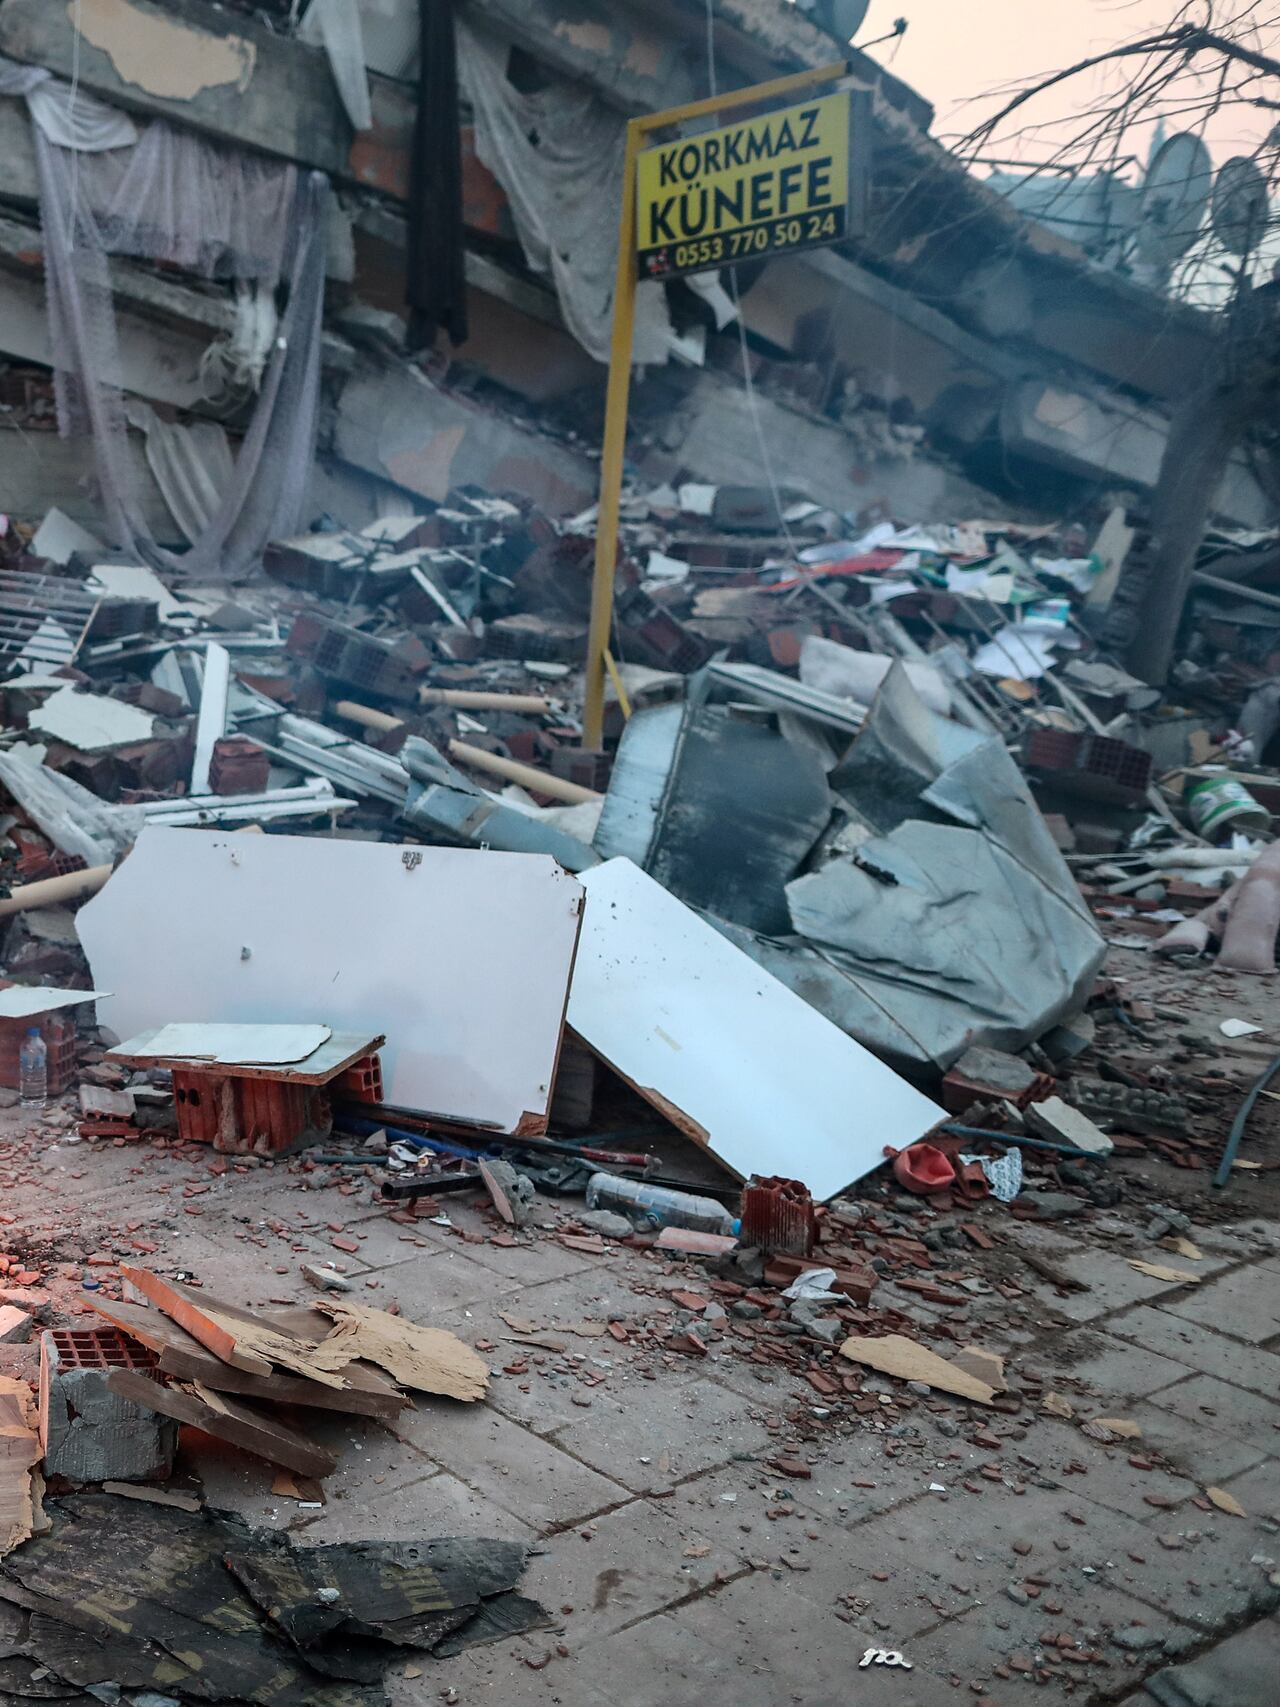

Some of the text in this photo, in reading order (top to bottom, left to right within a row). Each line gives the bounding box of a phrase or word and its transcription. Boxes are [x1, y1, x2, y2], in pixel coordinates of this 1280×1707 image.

[659, 108, 821, 187] KORKMAZ
[650, 156, 833, 244] KÜNEFE
[675, 212, 836, 267] 0553 770 50 24
